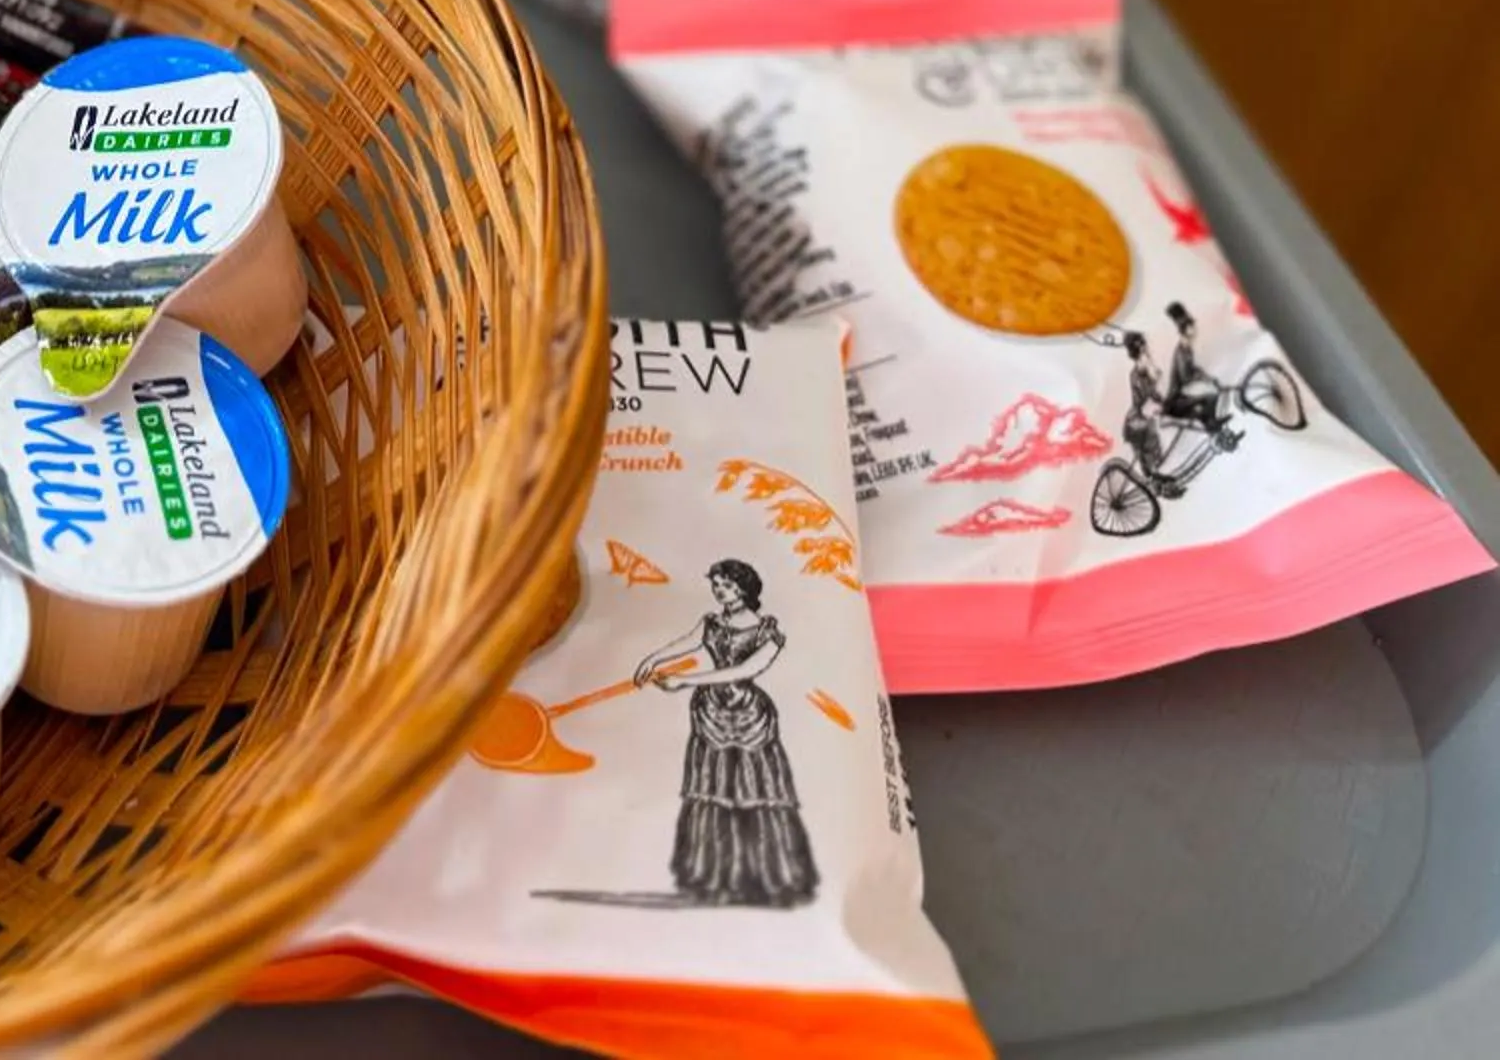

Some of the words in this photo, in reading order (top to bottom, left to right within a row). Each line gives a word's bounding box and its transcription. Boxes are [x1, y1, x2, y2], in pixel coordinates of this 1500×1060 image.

[101, 98, 240, 129] Lakeland
[104, 131, 223, 150] DAIRIES
[91, 159, 199, 182] WHOLE
[48, 188, 214, 246] Milk
[610, 351, 750, 395] REW
[13, 399, 107, 555] Milk
[100, 412, 144, 516] WHOLE
[142, 414, 187, 531] DAIRIES
[168, 401, 231, 540] Lakeland
[877, 694, 895, 776] BEFORE
[886, 778, 901, 832] BEST
